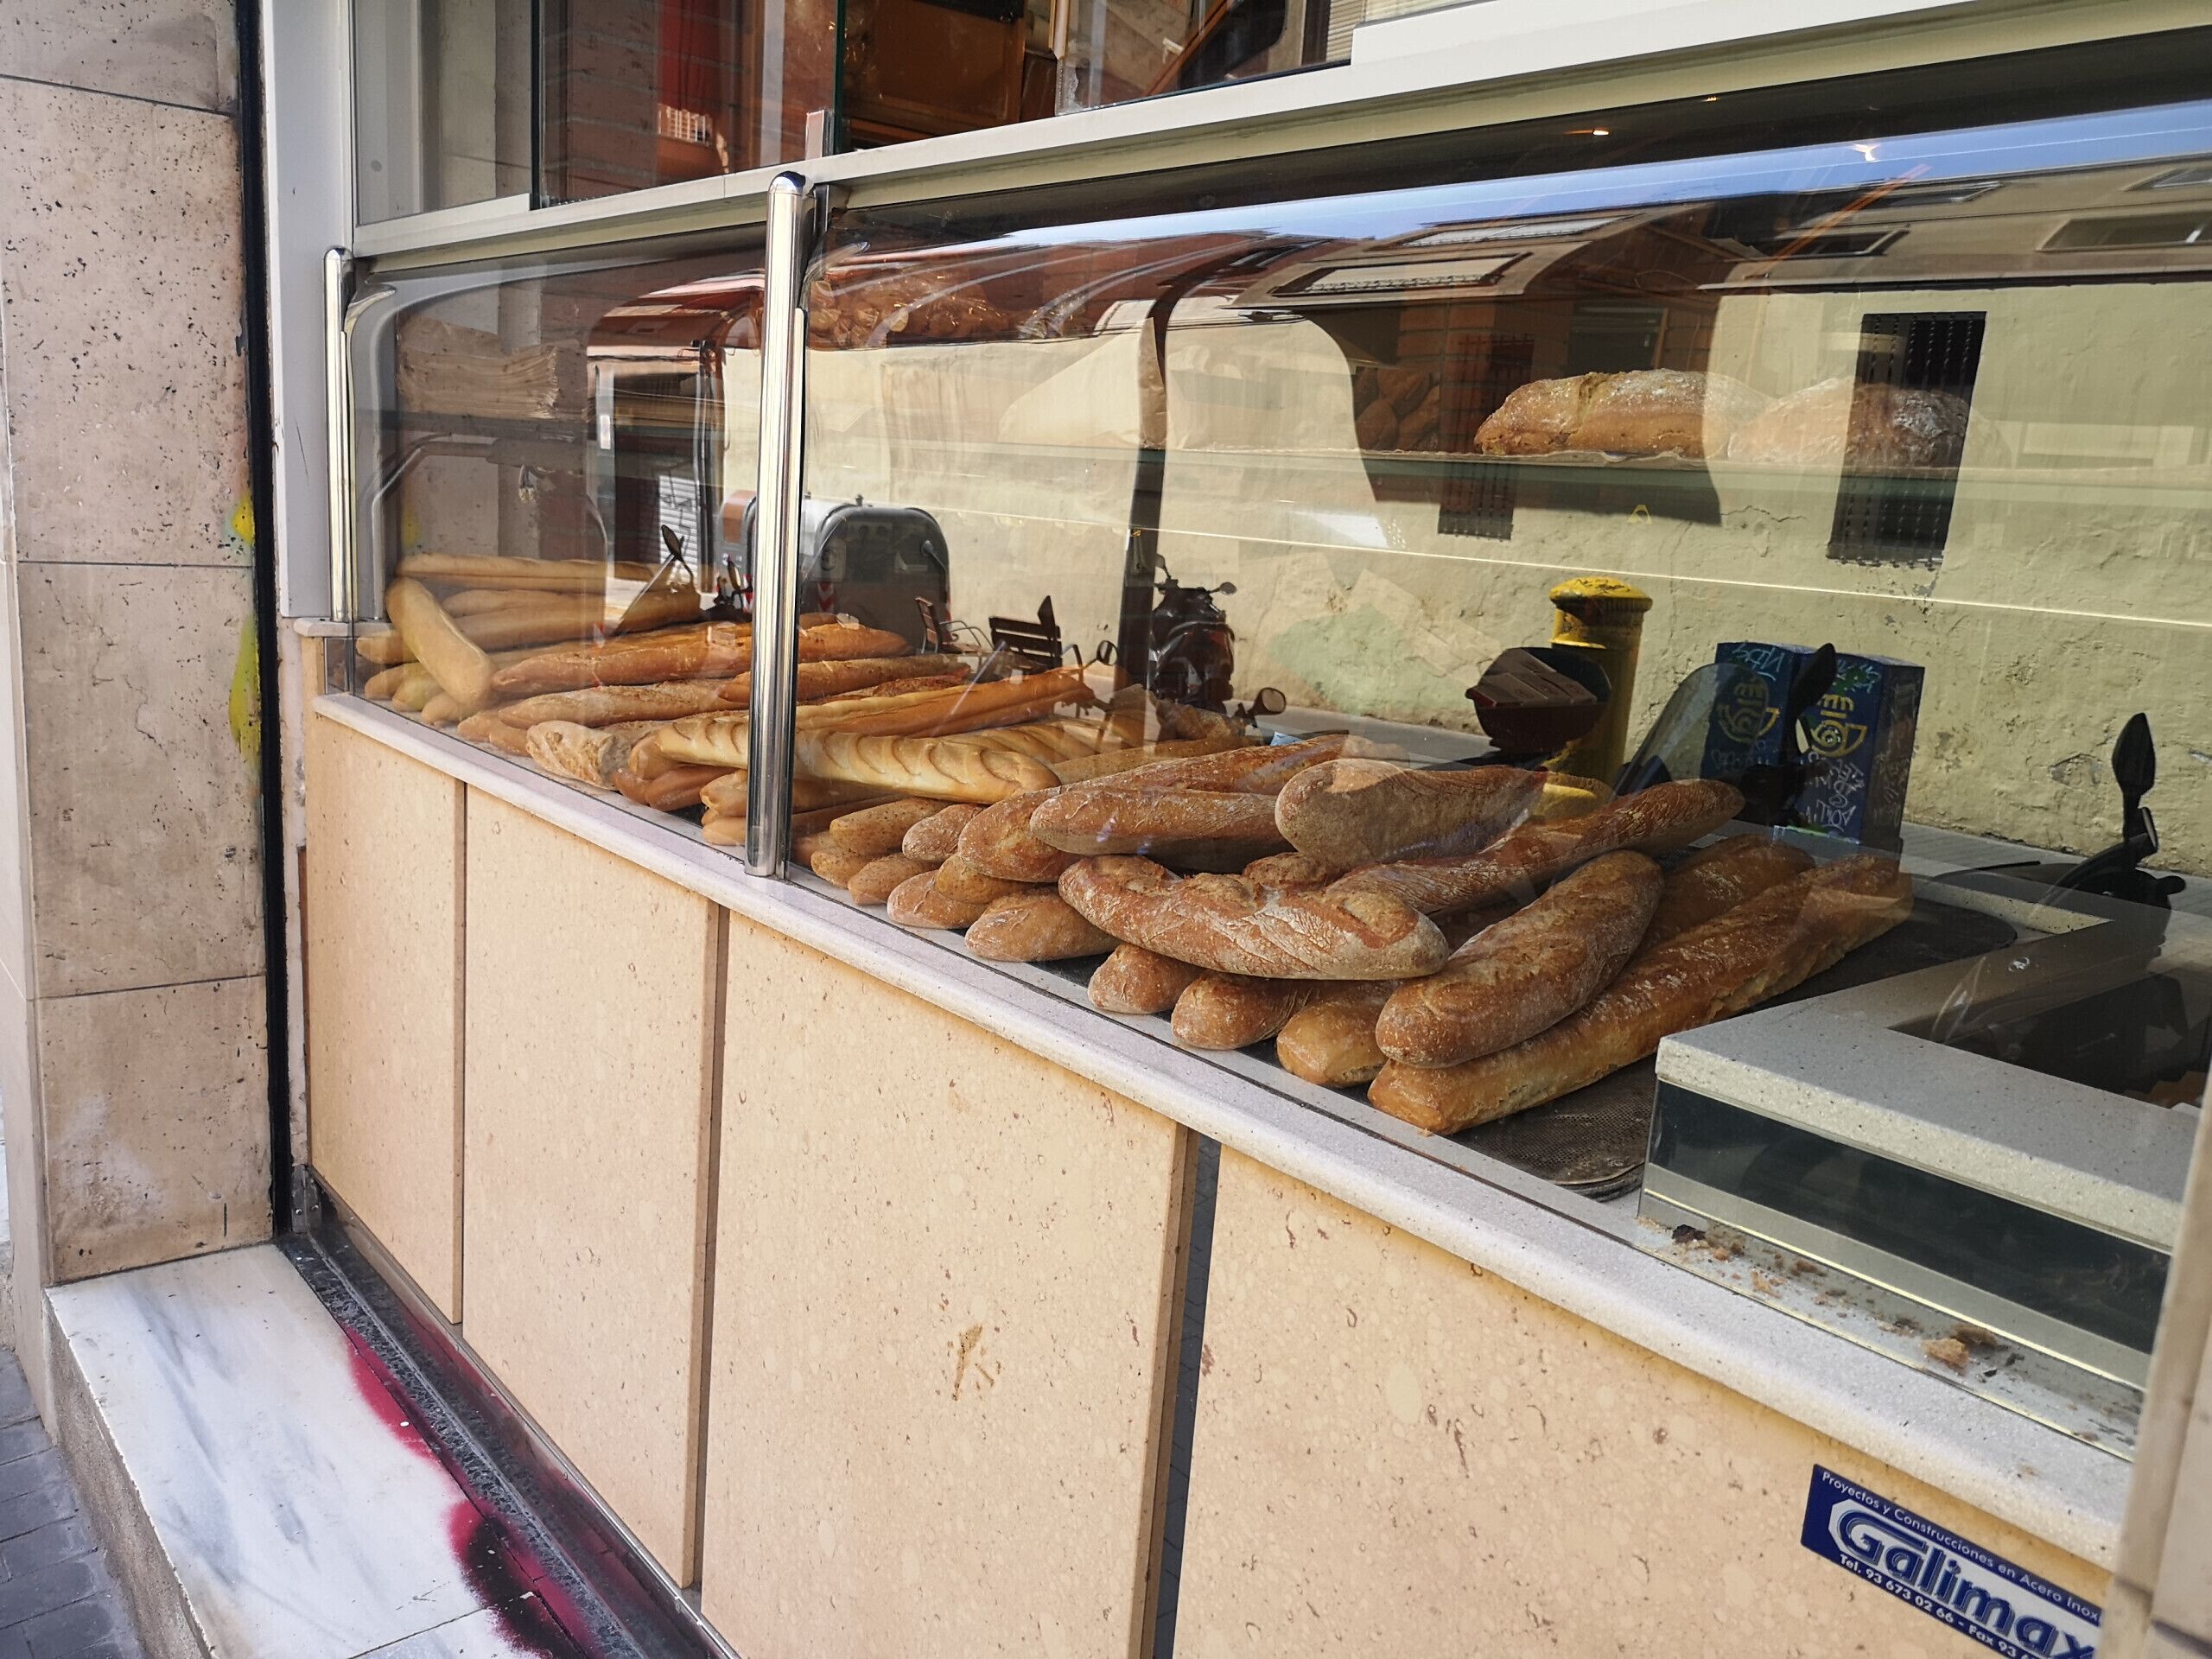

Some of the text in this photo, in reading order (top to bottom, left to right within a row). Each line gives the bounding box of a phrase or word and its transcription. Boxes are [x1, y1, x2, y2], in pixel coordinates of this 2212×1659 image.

[1822, 1471, 1879, 1510] Proyectos
[1883, 1504, 1891, 1515] y
[1894, 1508, 1993, 1567] Construcciones
[1998, 1563, 2016, 1579] en
[2019, 1574, 2063, 1603] Acero
[1837, 1509, 2095, 1659] Galimax
[1840, 1554, 1861, 1573] Tel.
[1866, 1568, 1883, 1584] 93
[1885, 1580, 1911, 1603] 673
[1915, 1594, 1933, 1611] 02
[1936, 1607, 1955, 1624] 66
[1968, 1624, 1993, 1646] Fax
[1998, 1640, 2017, 1658] 93
